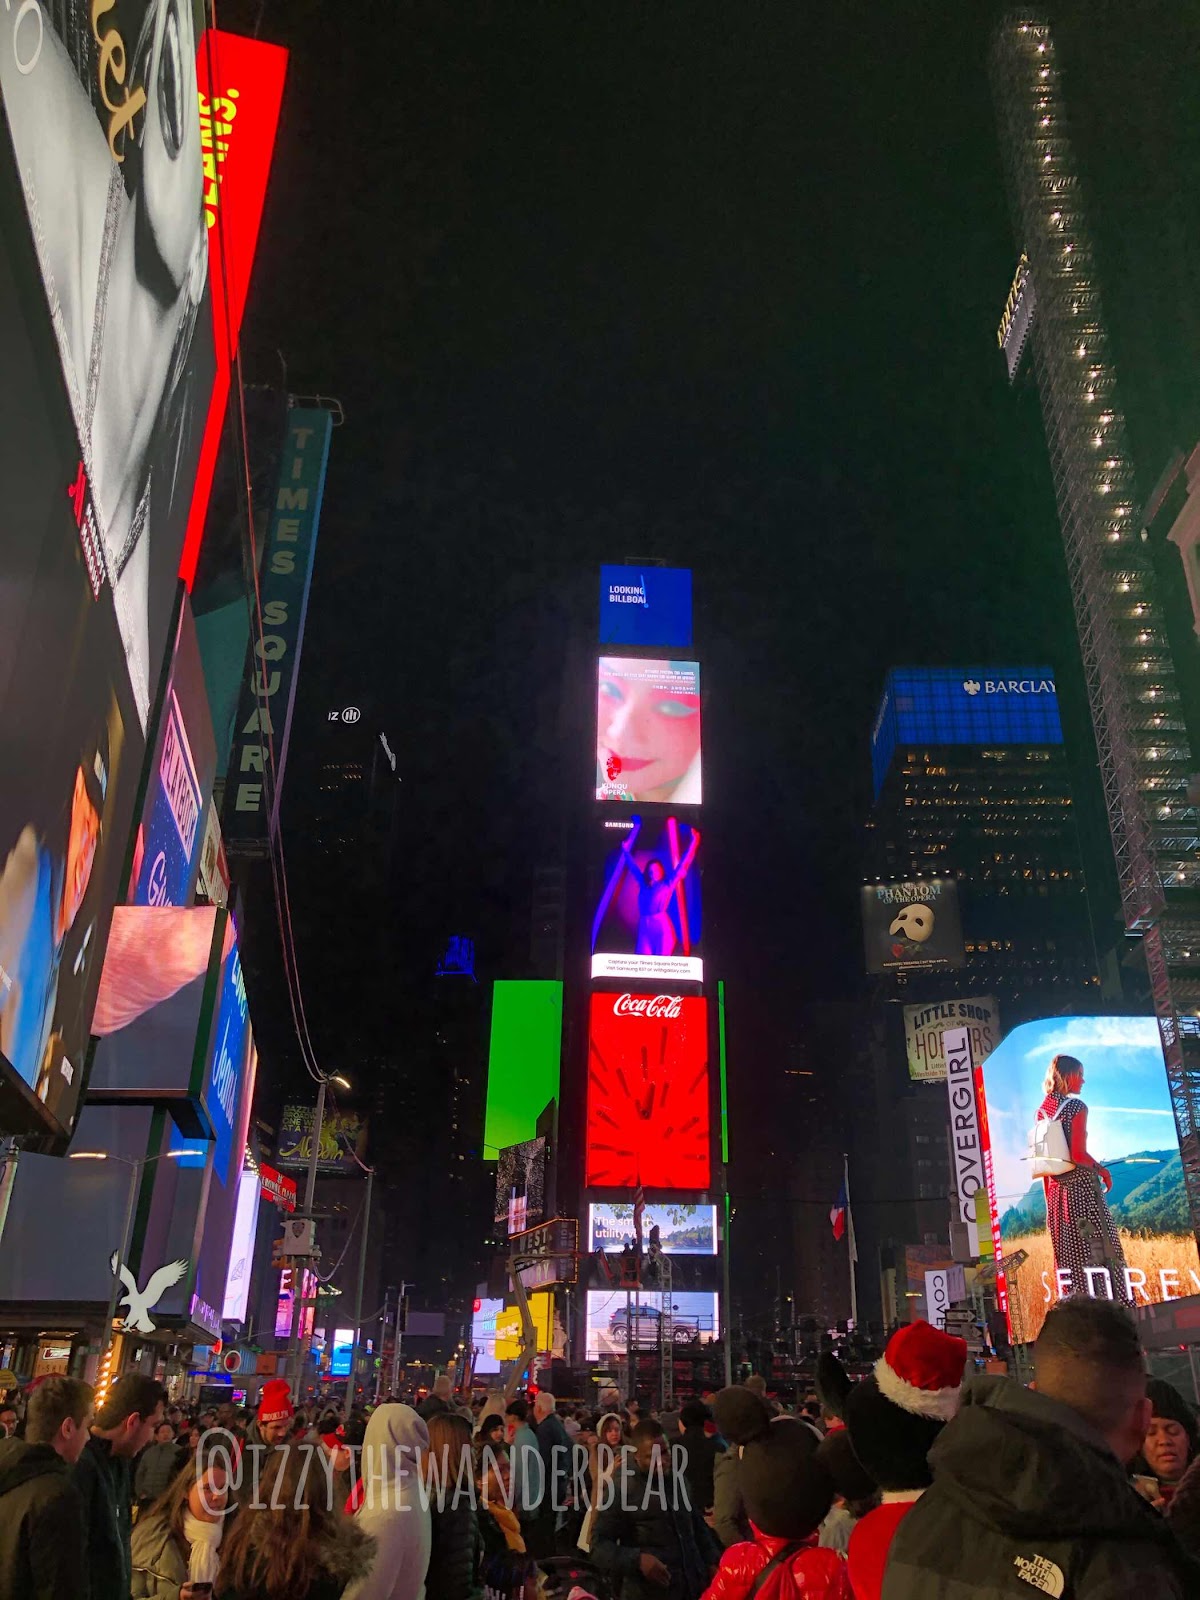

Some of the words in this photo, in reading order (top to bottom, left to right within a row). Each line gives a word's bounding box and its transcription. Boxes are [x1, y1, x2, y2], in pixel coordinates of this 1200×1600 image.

[270, 428, 314, 575] TIMES
[235, 600, 289, 811] SQUARE
[877, 885, 942, 900] PHANTOM
[911, 894, 937, 902] OPERA
[613, 993, 684, 1018] Coca-Cola
[914, 1004, 956, 1030] LITTLE
[958, 1004, 991, 1023] SHOP
[915, 1026, 994, 1070] HORS
[283, 1104, 328, 1113] DAZZLIG
[283, 1112, 327, 1120] BROADWY
[282, 1118, 301, 1126] ONE
[947, 1037, 981, 1223] COVERGIRL
[595, 1216, 615, 1226] The
[595, 1229, 625, 1240] utility
[262, 1410, 289, 1421] BROOKLYN
[1014, 1556, 1050, 1581] NORTH
[1033, 1554, 1053, 1571] THE
[1017, 1569, 1045, 1589] FACE
